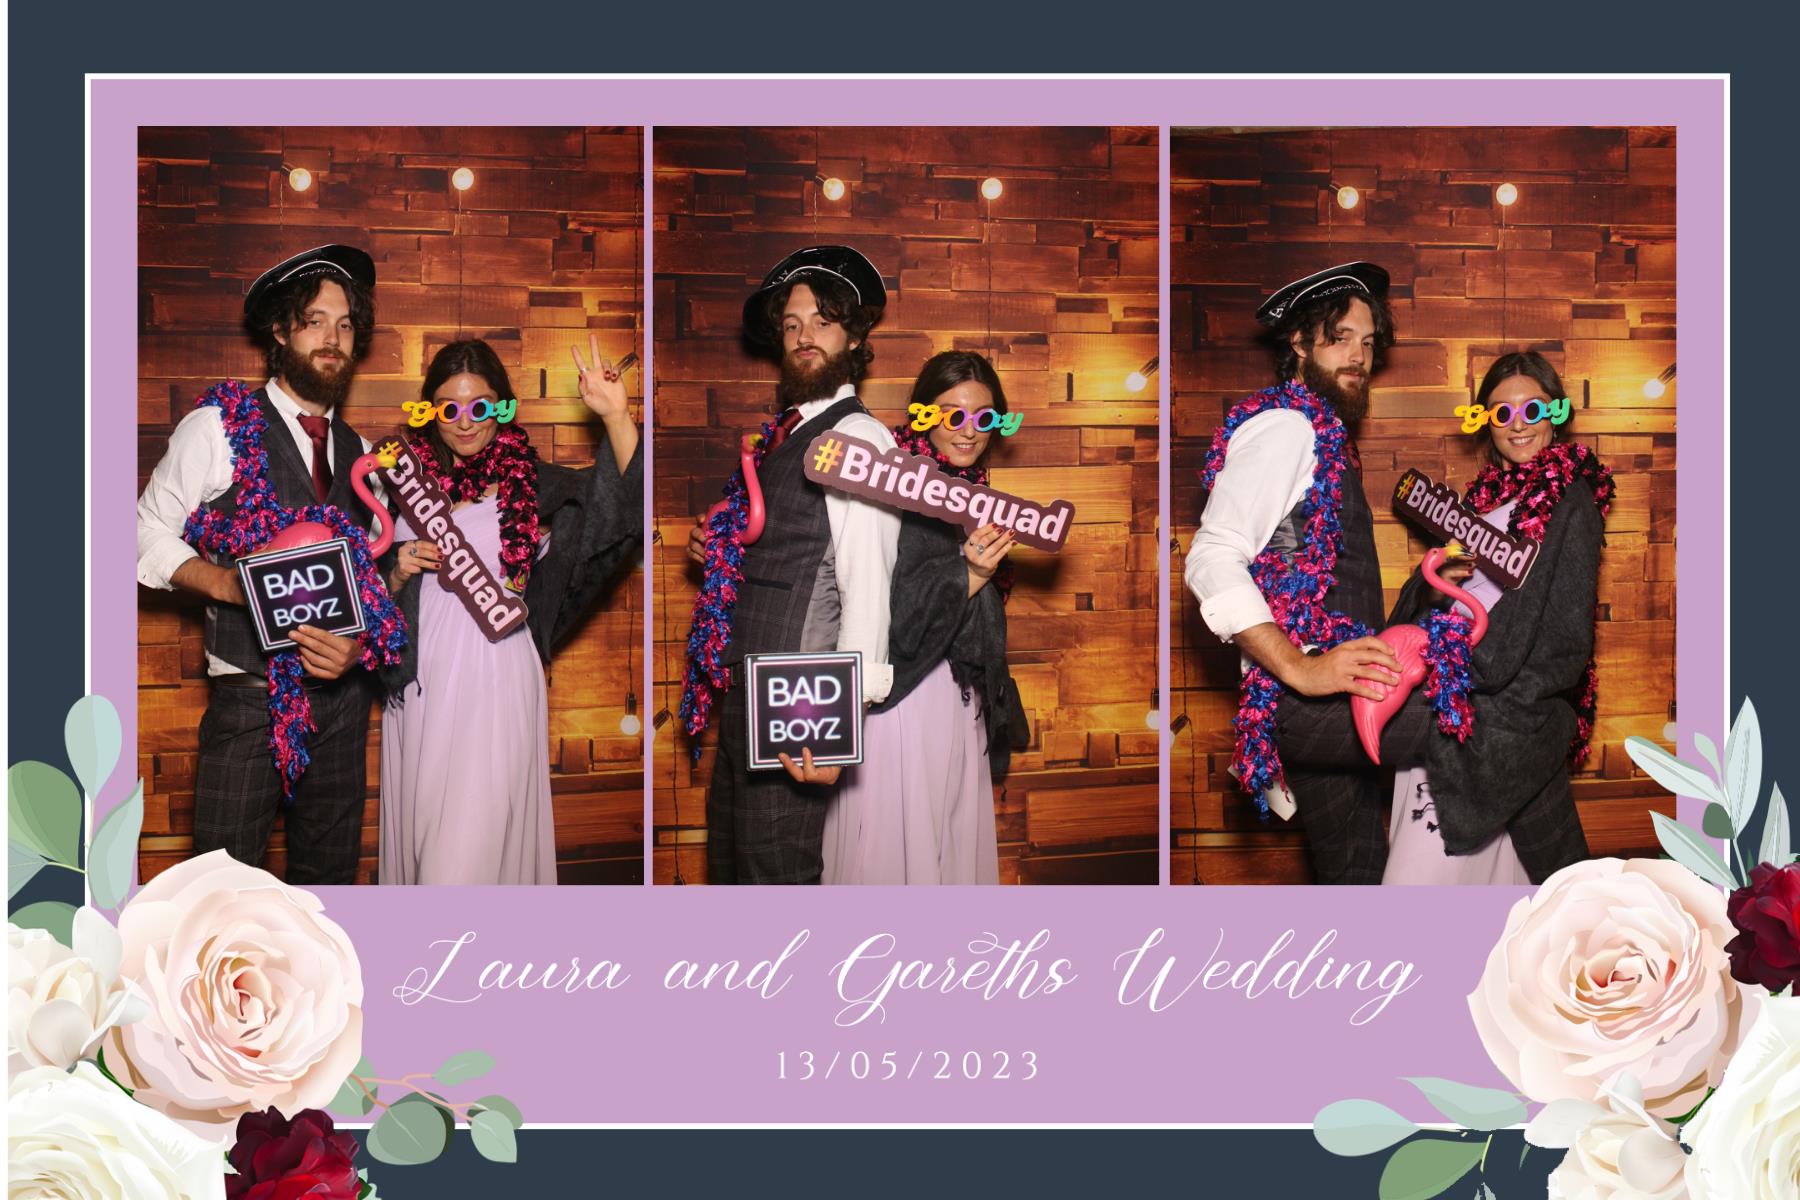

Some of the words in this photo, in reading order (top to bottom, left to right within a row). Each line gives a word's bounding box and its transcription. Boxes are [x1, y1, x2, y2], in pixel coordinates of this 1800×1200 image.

[814, 438, 1069, 544] #Bridesquad
[1397, 474, 1533, 578] #Bridesquad
[263, 564, 334, 599] BAD
[274, 598, 343, 628] BOYZ
[767, 676, 841, 707] BAD
[769, 717, 841, 743] BOYZ
